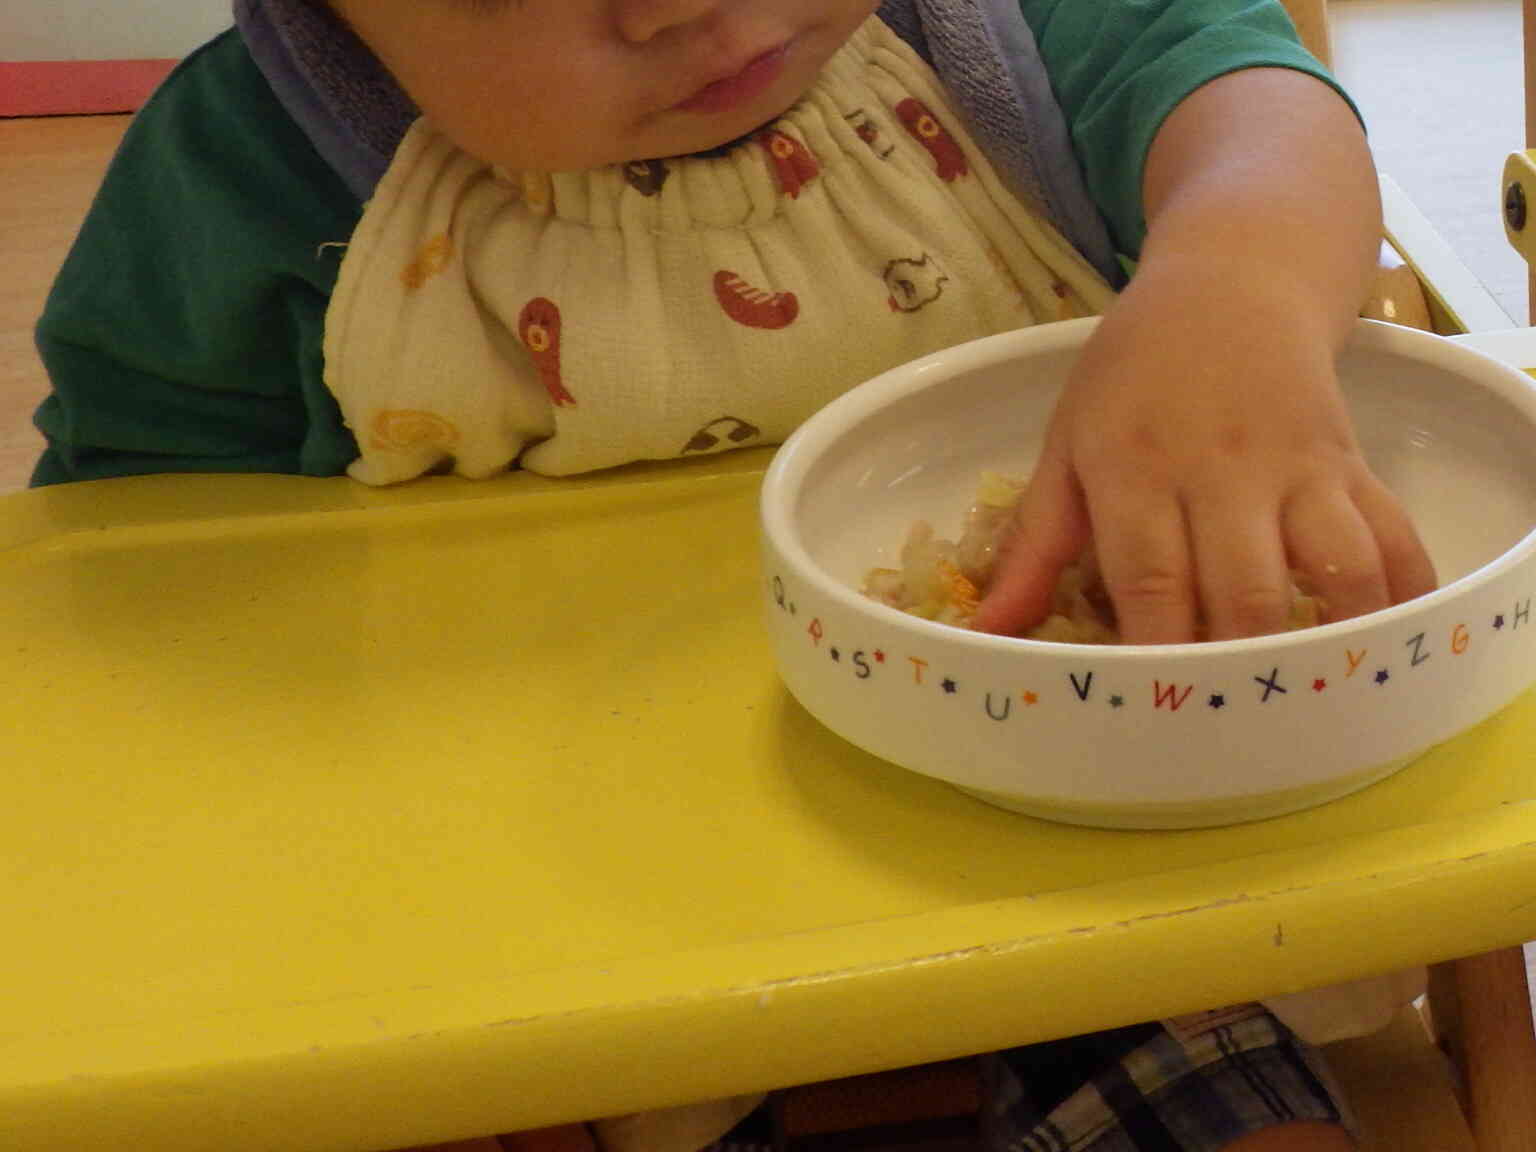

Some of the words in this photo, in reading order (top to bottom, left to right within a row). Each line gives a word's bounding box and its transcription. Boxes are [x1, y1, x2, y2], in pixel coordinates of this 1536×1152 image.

[853, 651, 870, 679] S
[908, 656, 929, 684] T
[985, 693, 1011, 721] U
[1070, 671, 1093, 701] V
[1152, 680, 1193, 712] W
[1254, 668, 1287, 702] X
[1405, 632, 1431, 666] Z
[1513, 598, 1530, 630] H
